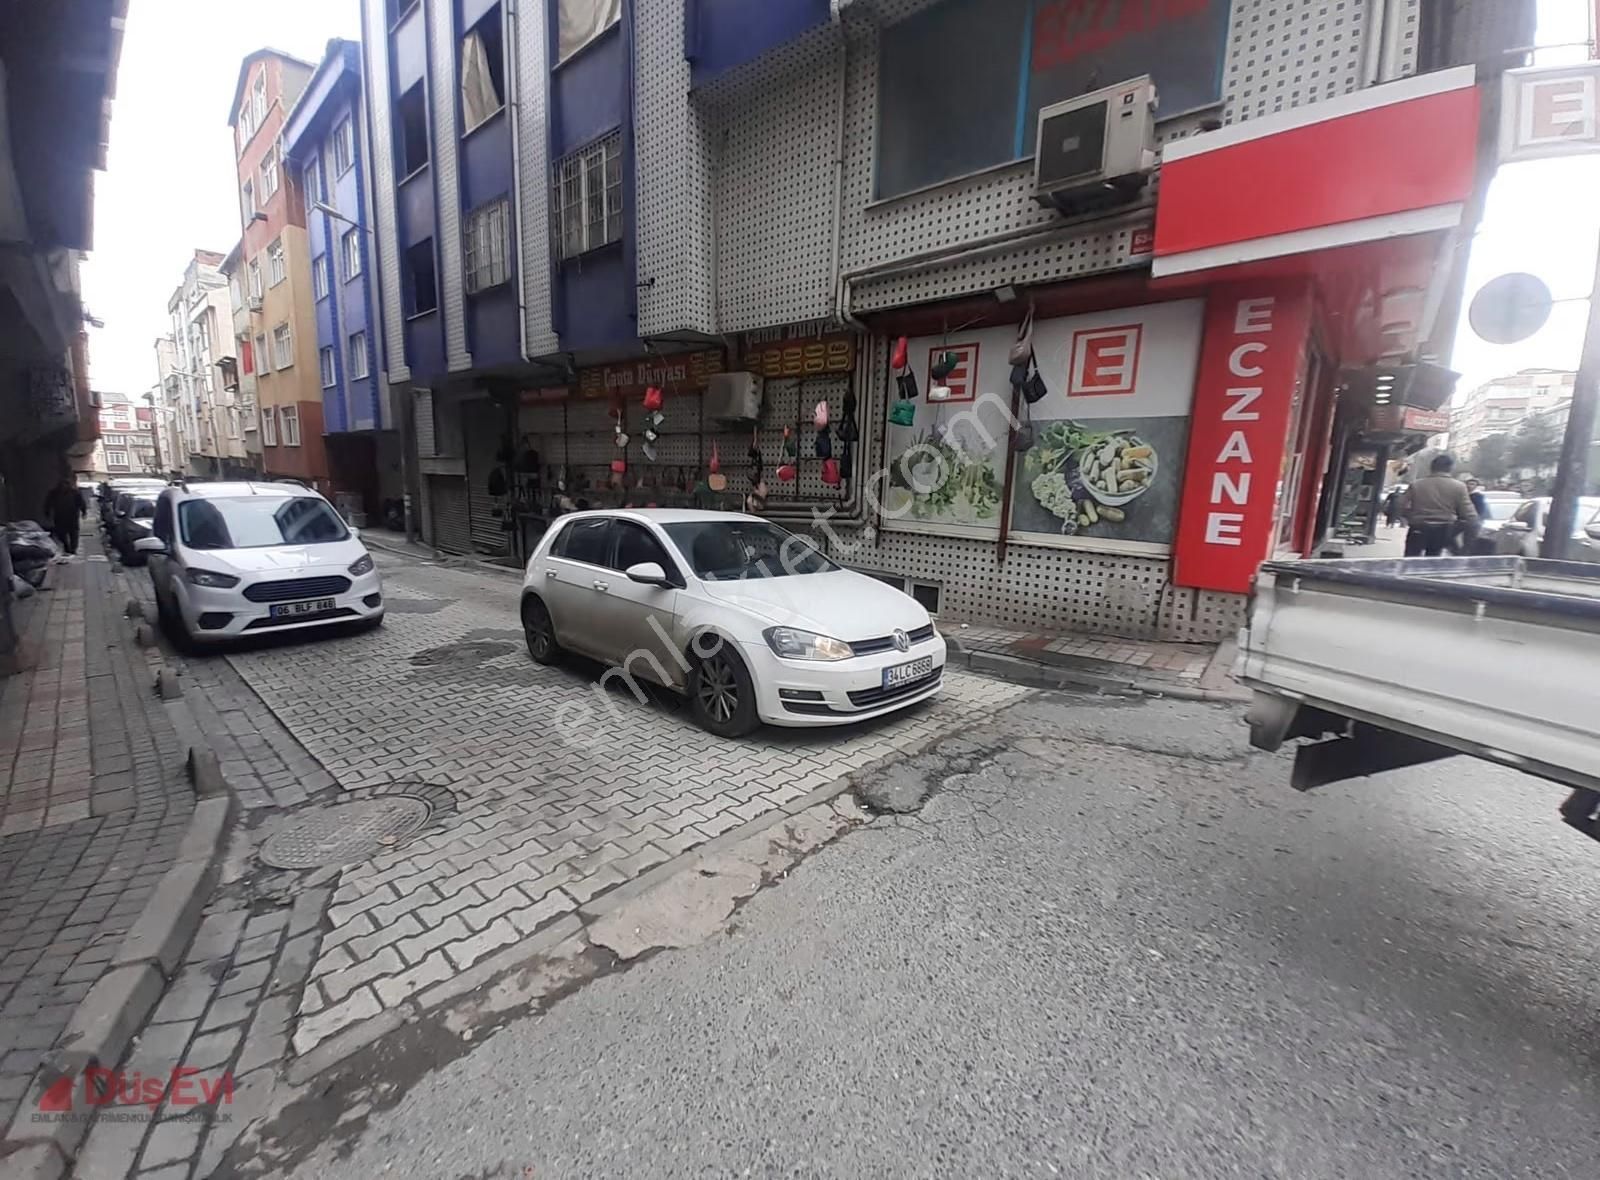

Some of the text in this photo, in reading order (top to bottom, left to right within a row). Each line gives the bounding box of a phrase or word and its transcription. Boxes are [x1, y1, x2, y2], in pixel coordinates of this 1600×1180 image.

[1532, 81, 1585, 139] E
[637, 363, 686, 388] Dünyası
[1081, 335, 1128, 388] E
[1204, 297, 1276, 546] ECZANE
